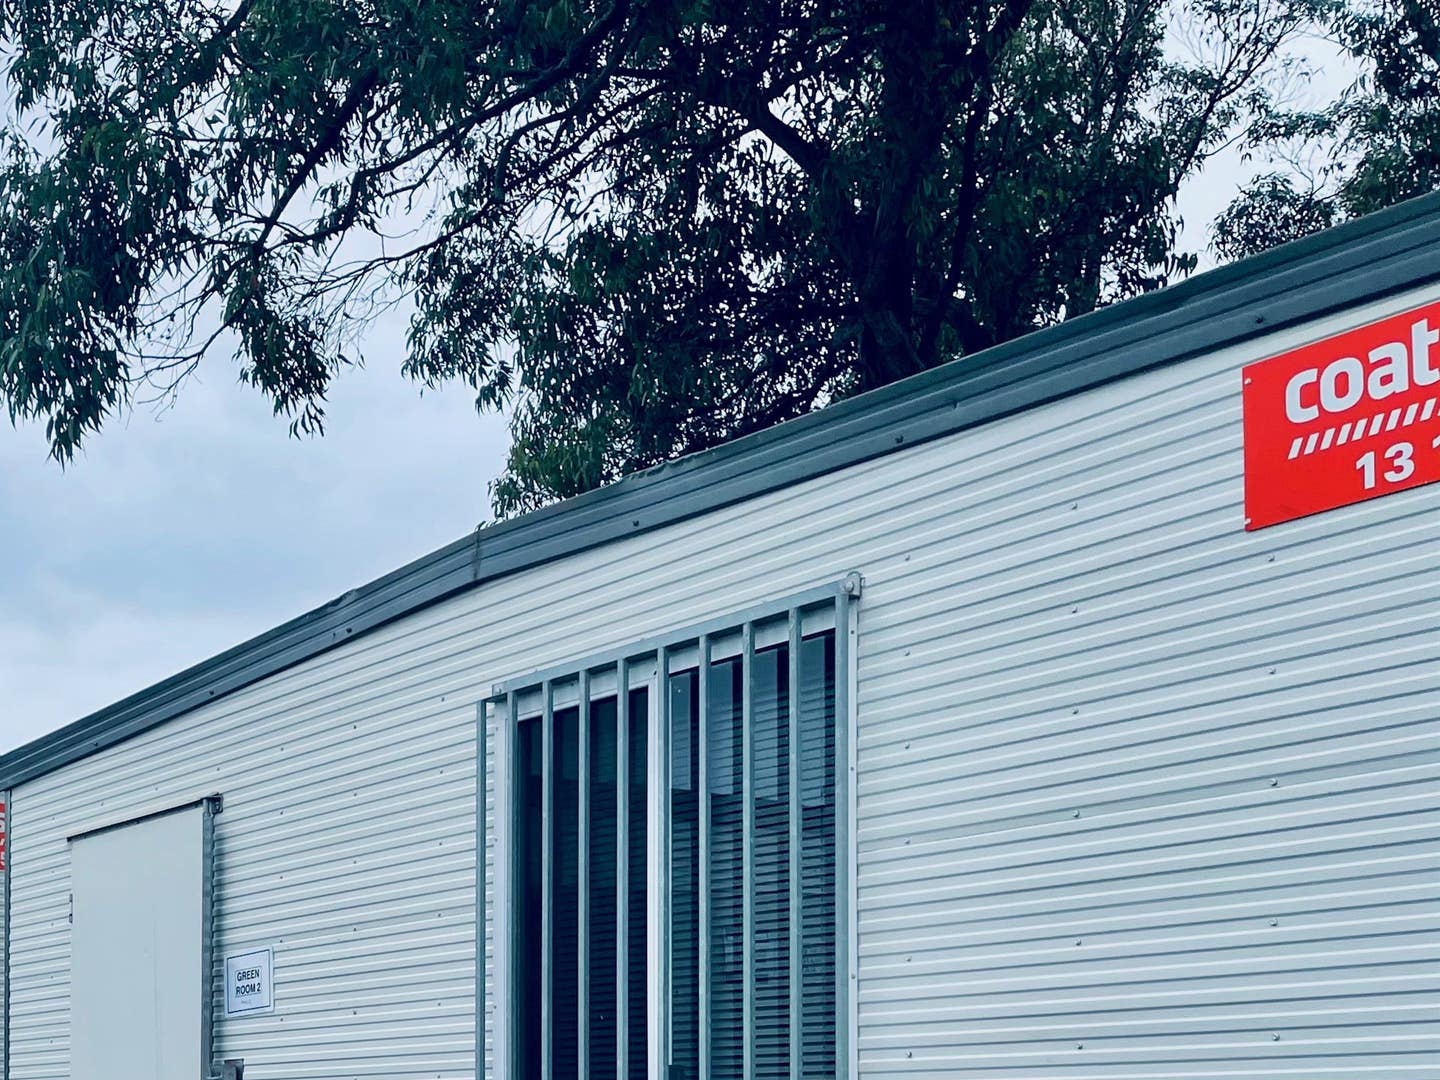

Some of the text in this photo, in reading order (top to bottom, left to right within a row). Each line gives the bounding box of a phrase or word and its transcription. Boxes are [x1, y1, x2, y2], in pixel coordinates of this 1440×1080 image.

[1285, 318, 1440, 424] coat
[1356, 442, 1415, 489] 13
[235, 982, 262, 996] ROOM 2
[236, 968, 260, 982] GREEN
